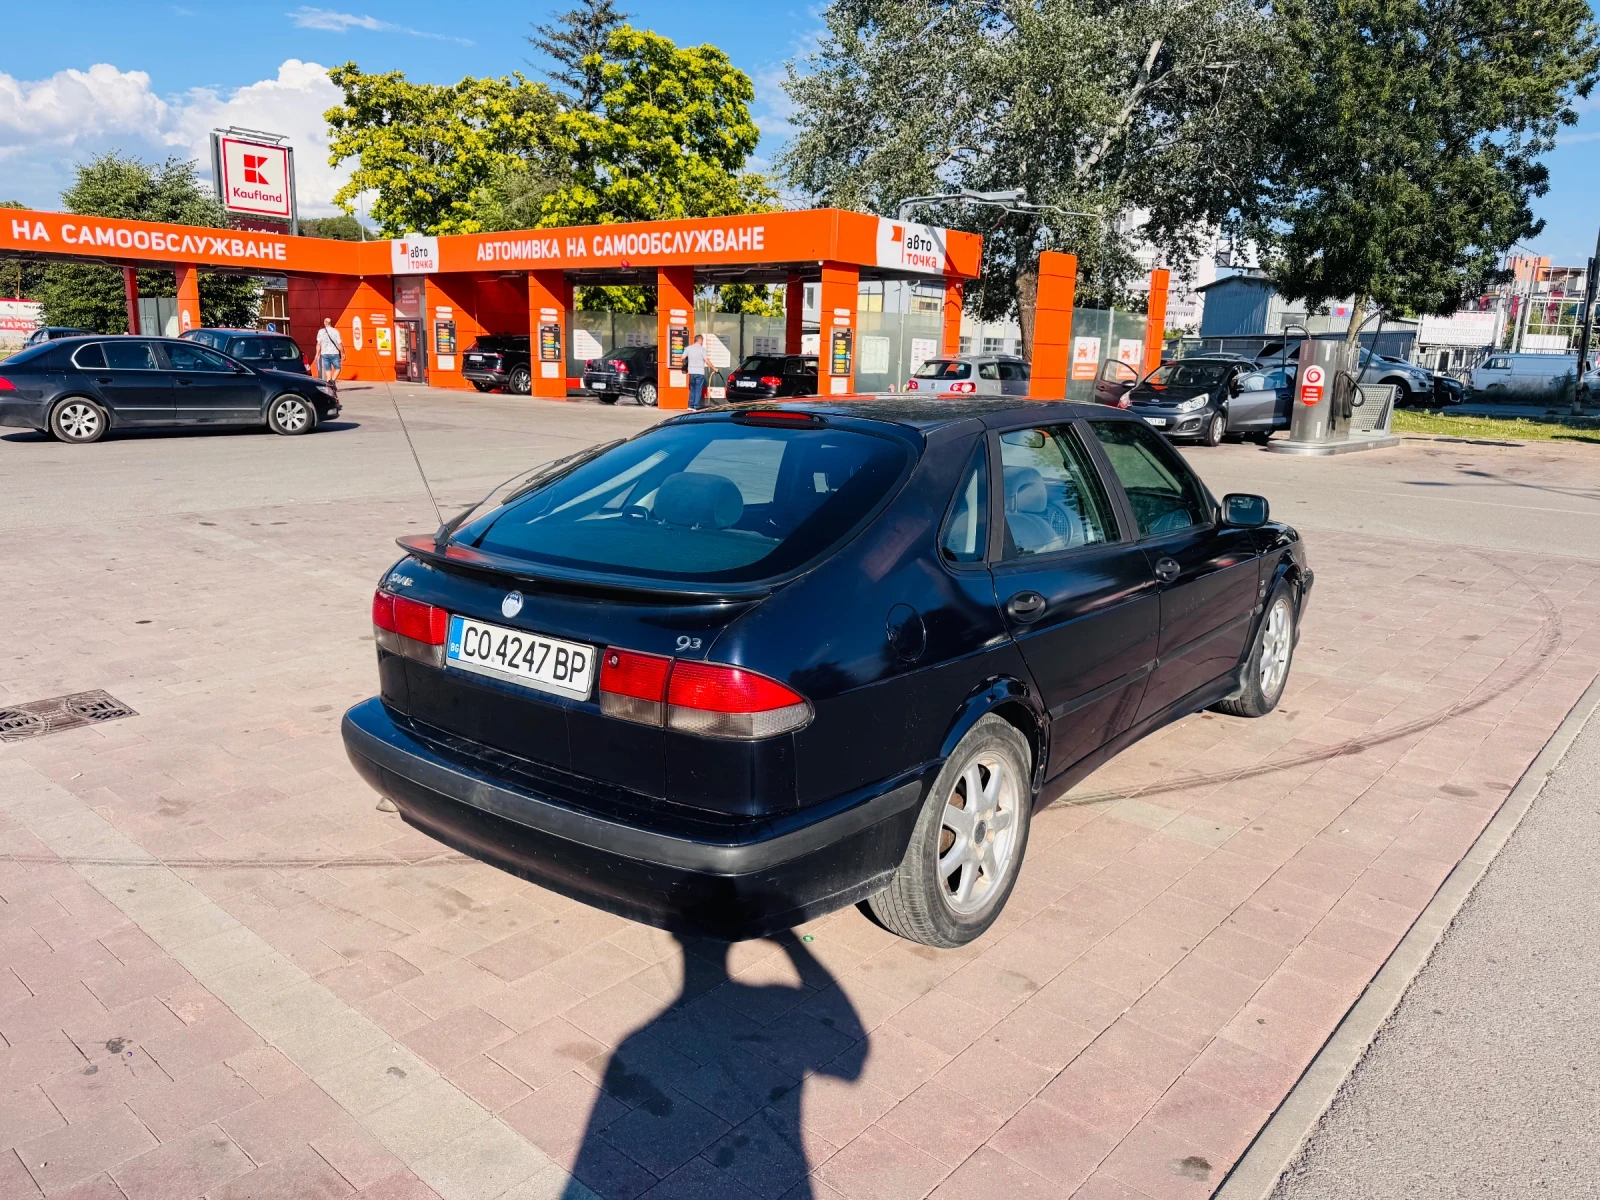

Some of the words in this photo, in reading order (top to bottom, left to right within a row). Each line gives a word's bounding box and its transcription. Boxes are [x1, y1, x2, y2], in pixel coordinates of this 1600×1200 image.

[233, 187, 282, 203] Kaufland
[11, 219, 51, 242] НА
[61, 224, 287, 261] САМООБСЛУЖВАНЕ
[476, 238, 561, 262] АВТОМИВКА
[566, 236, 587, 258] НА
[592, 226, 765, 257] САМООБСЛУЖВАНЕ
[907, 234, 932, 252] авто
[410, 245, 428, 258] авто
[411, 259, 433, 270] точка
[906, 253, 937, 269] точка
[450, 642, 460, 652] BG
[675, 635, 702, 652] 93
[463, 626, 492, 660] CO
[495, 634, 552, 674] 4247
[552, 647, 586, 683] BP
